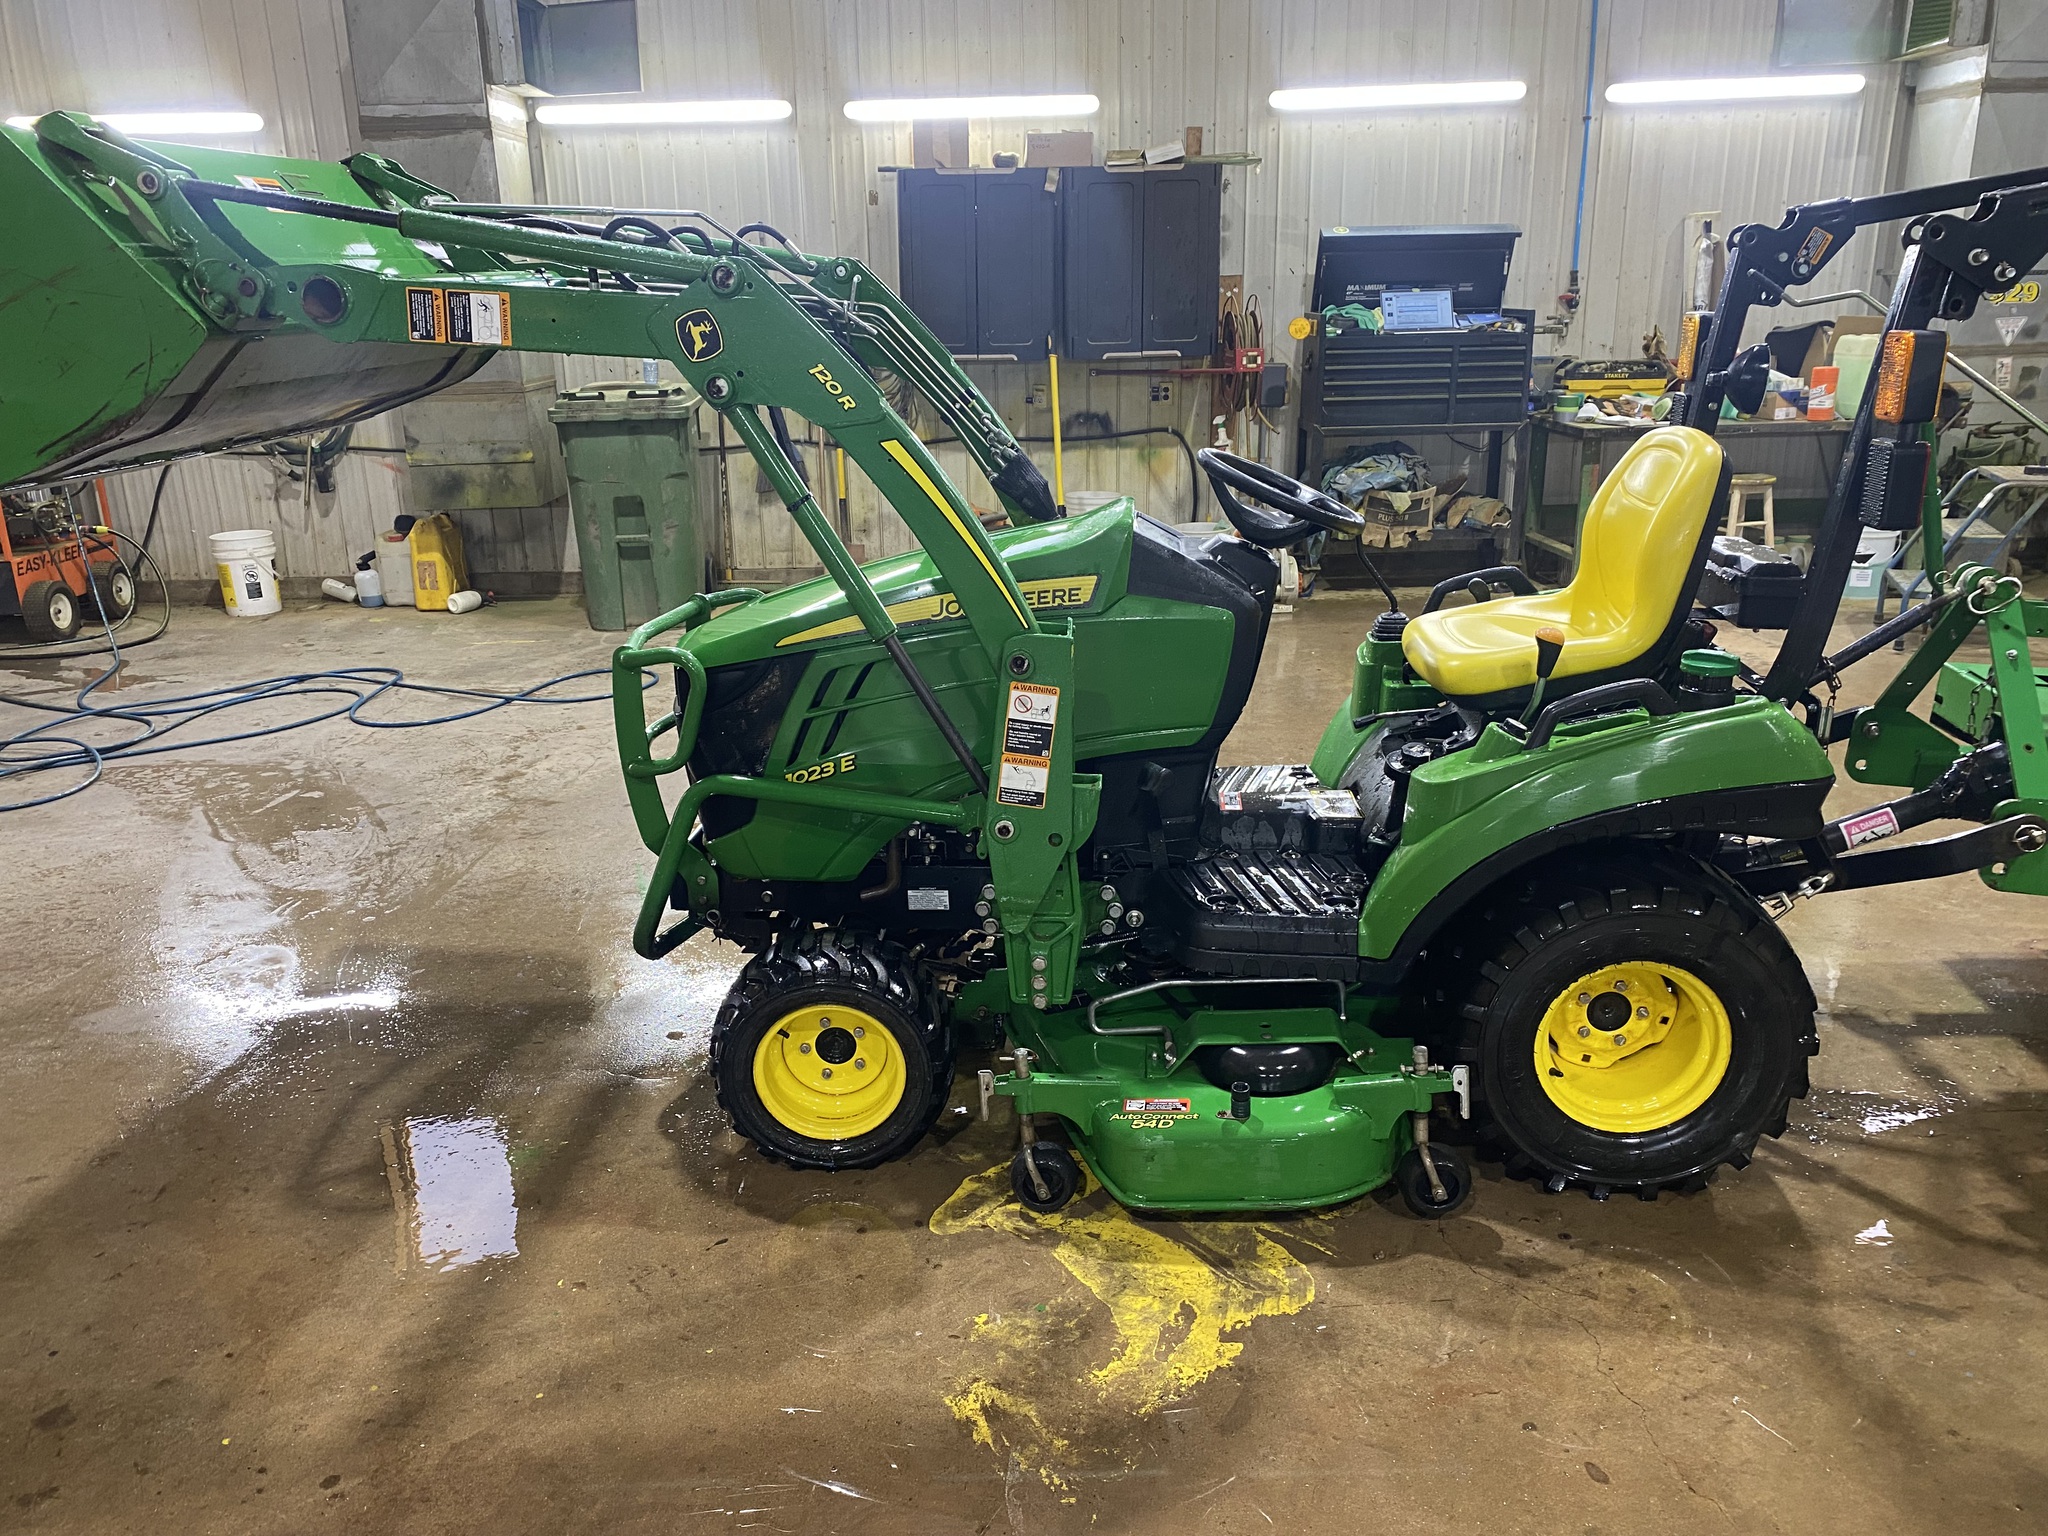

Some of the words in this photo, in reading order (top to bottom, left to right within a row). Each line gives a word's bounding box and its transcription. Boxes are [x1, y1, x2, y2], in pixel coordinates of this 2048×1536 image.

[434, 303, 444, 338] WARNING
[501, 307, 510, 341] WARNING
[807, 362, 844, 395] 120
[837, 394, 857, 412] R
[1377, 512, 1394, 523] PLUS
[1024, 586, 1083, 607] EERE
[1020, 684, 1057, 695] WARNING
[784, 761, 835, 784] 1023
[840, 754, 856, 773] E
[1011, 758, 1048, 768] WARNING
[1859, 815, 1889, 830] DANGER
[1131, 1119, 1175, 1129] 54D
